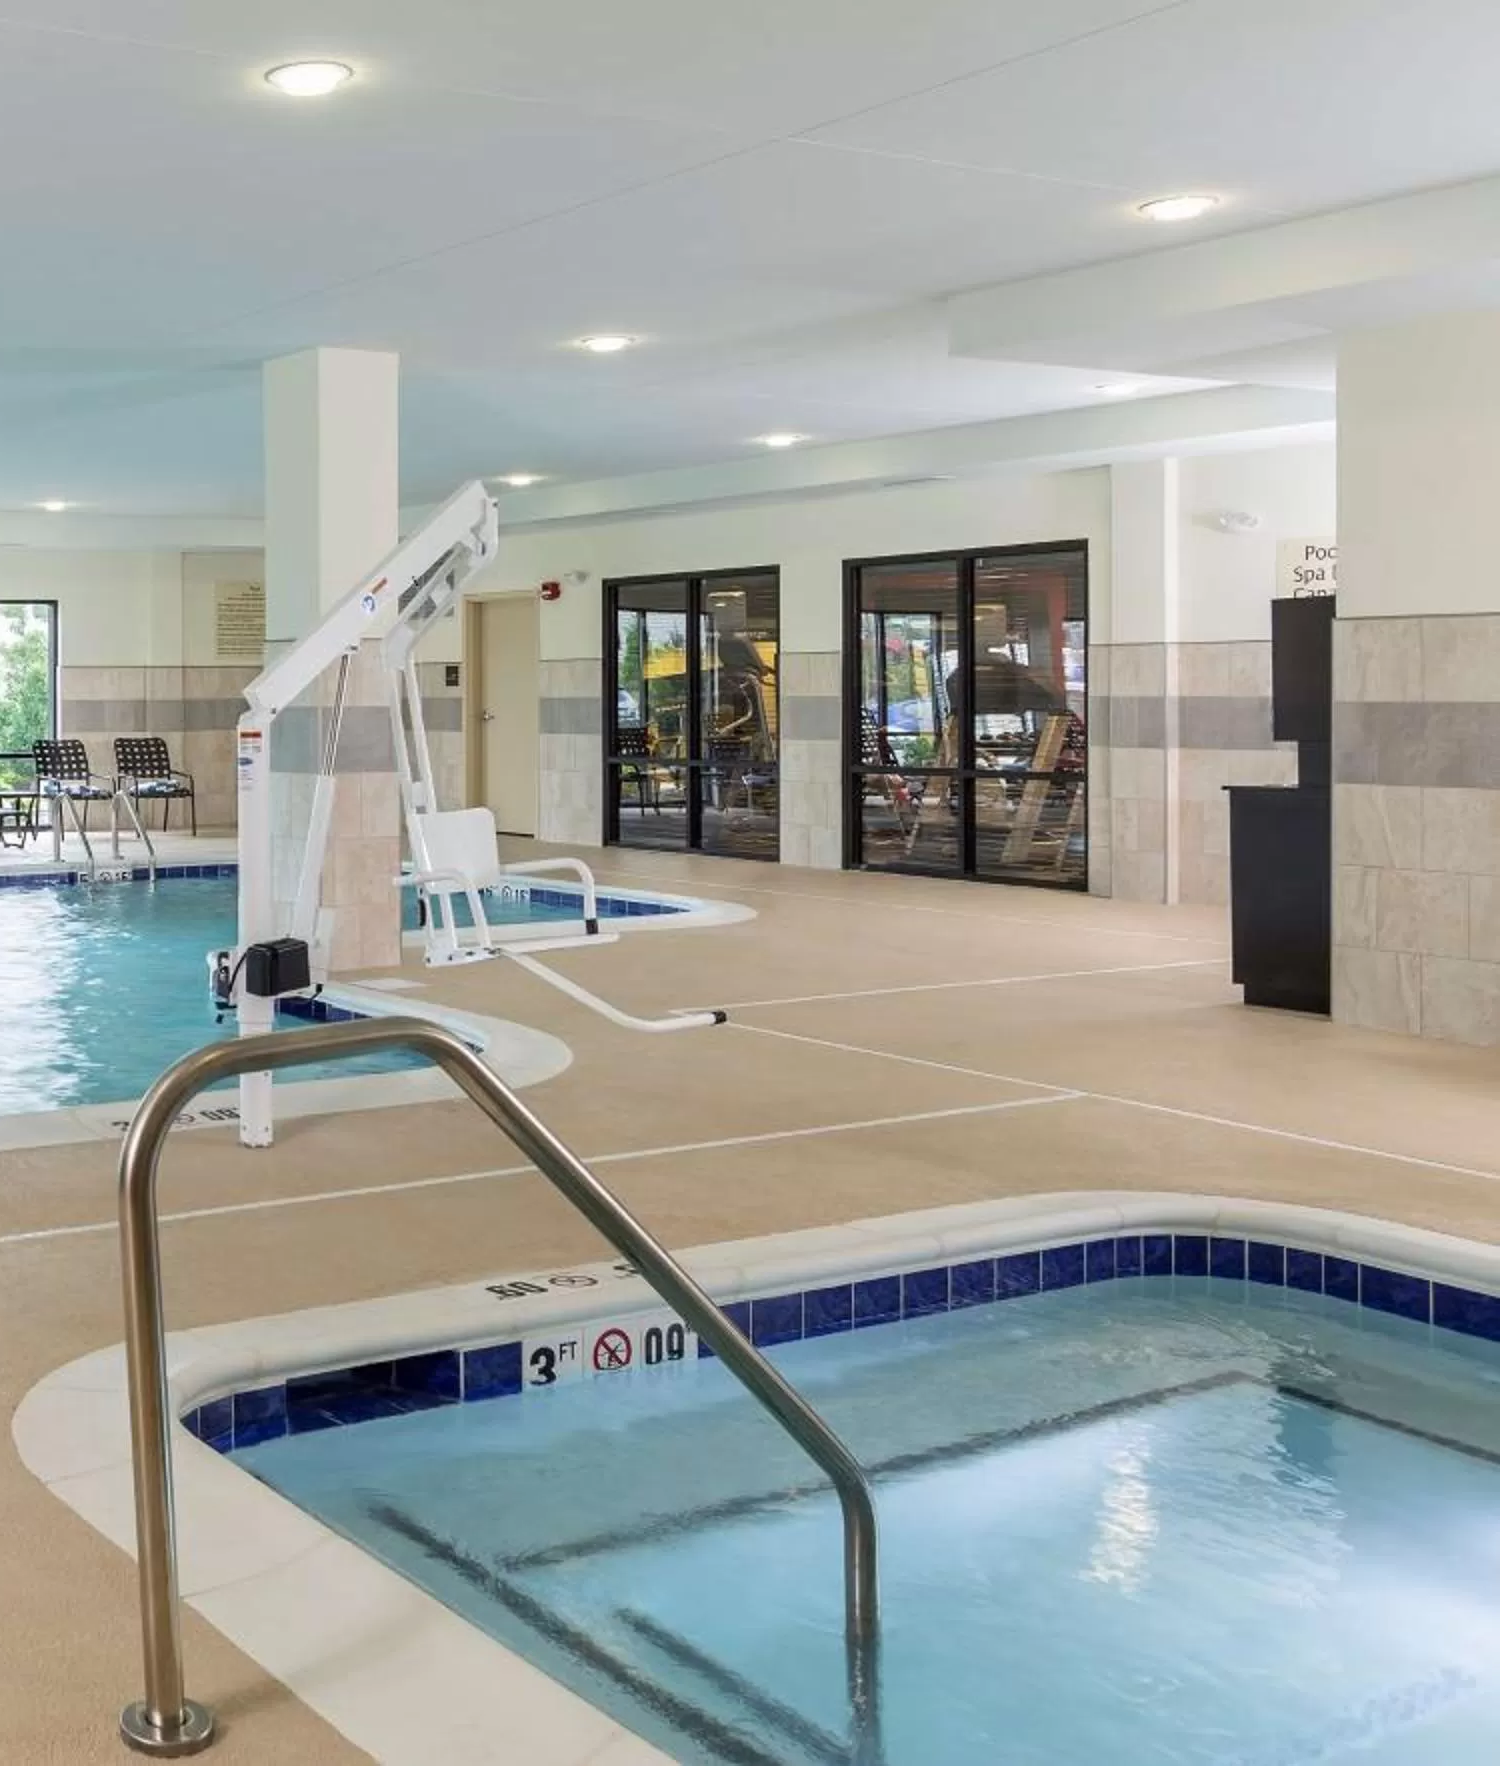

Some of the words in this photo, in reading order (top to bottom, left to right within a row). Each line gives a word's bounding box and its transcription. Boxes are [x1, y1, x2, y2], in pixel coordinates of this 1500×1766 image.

[1293, 565, 1326, 585] Spa
[529, 1346, 557, 1387] 3
[559, 1340, 577, 1363] FT
[644, 1322, 685, 1366] 09
